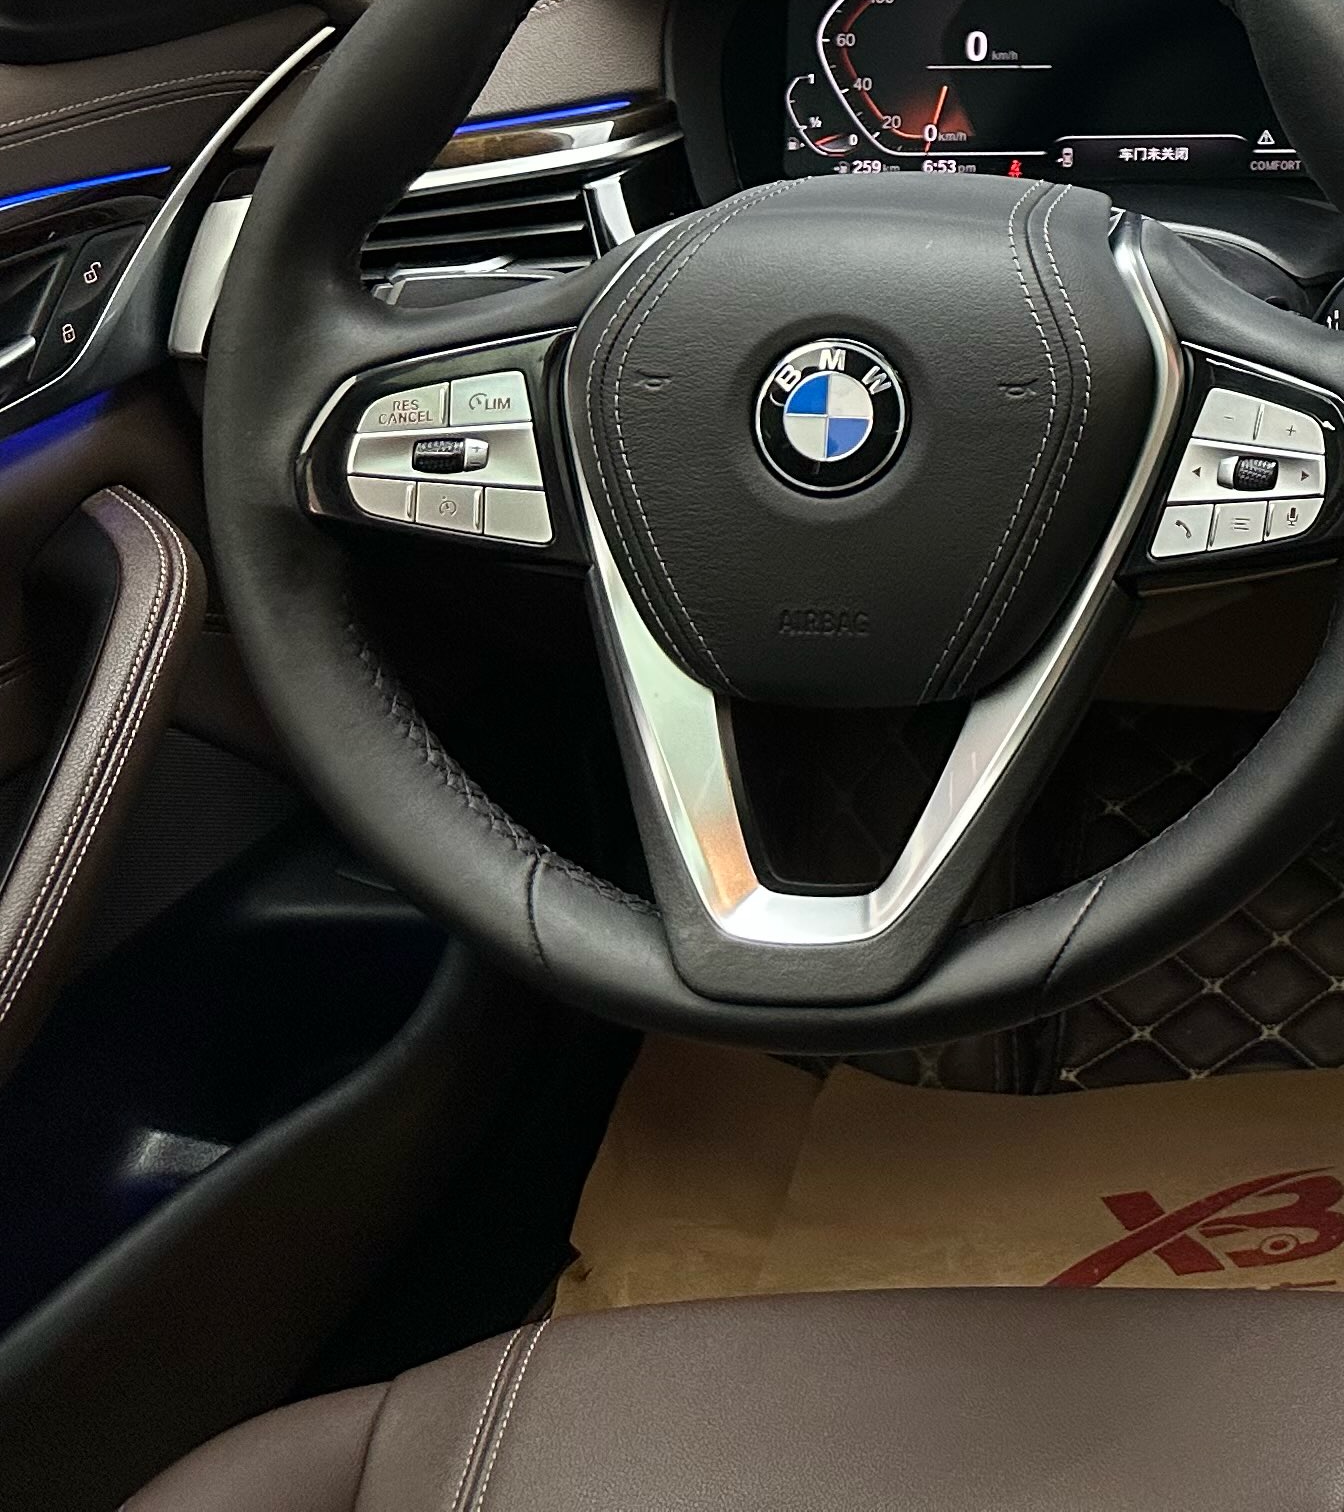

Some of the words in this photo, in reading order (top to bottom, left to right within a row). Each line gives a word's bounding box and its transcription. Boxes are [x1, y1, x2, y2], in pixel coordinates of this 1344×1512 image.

[836, 33, 856, 47] 60
[965, 30, 988, 62] 0
[853, 77, 873, 91] 40
[882, 115, 902, 130] 20
[923, 123, 938, 143] 0
[1118, 147, 1190, 162] 车门未关闭
[852, 160, 882, 175] 259
[1250, 159, 1301, 171] COMFORT
[774, 348, 892, 395] BMW
[393, 399, 420, 411] RES
[485, 397, 511, 411] LIM
[378, 410, 434, 425] CANCEL
[778, 608, 871, 637] AIRBAG
